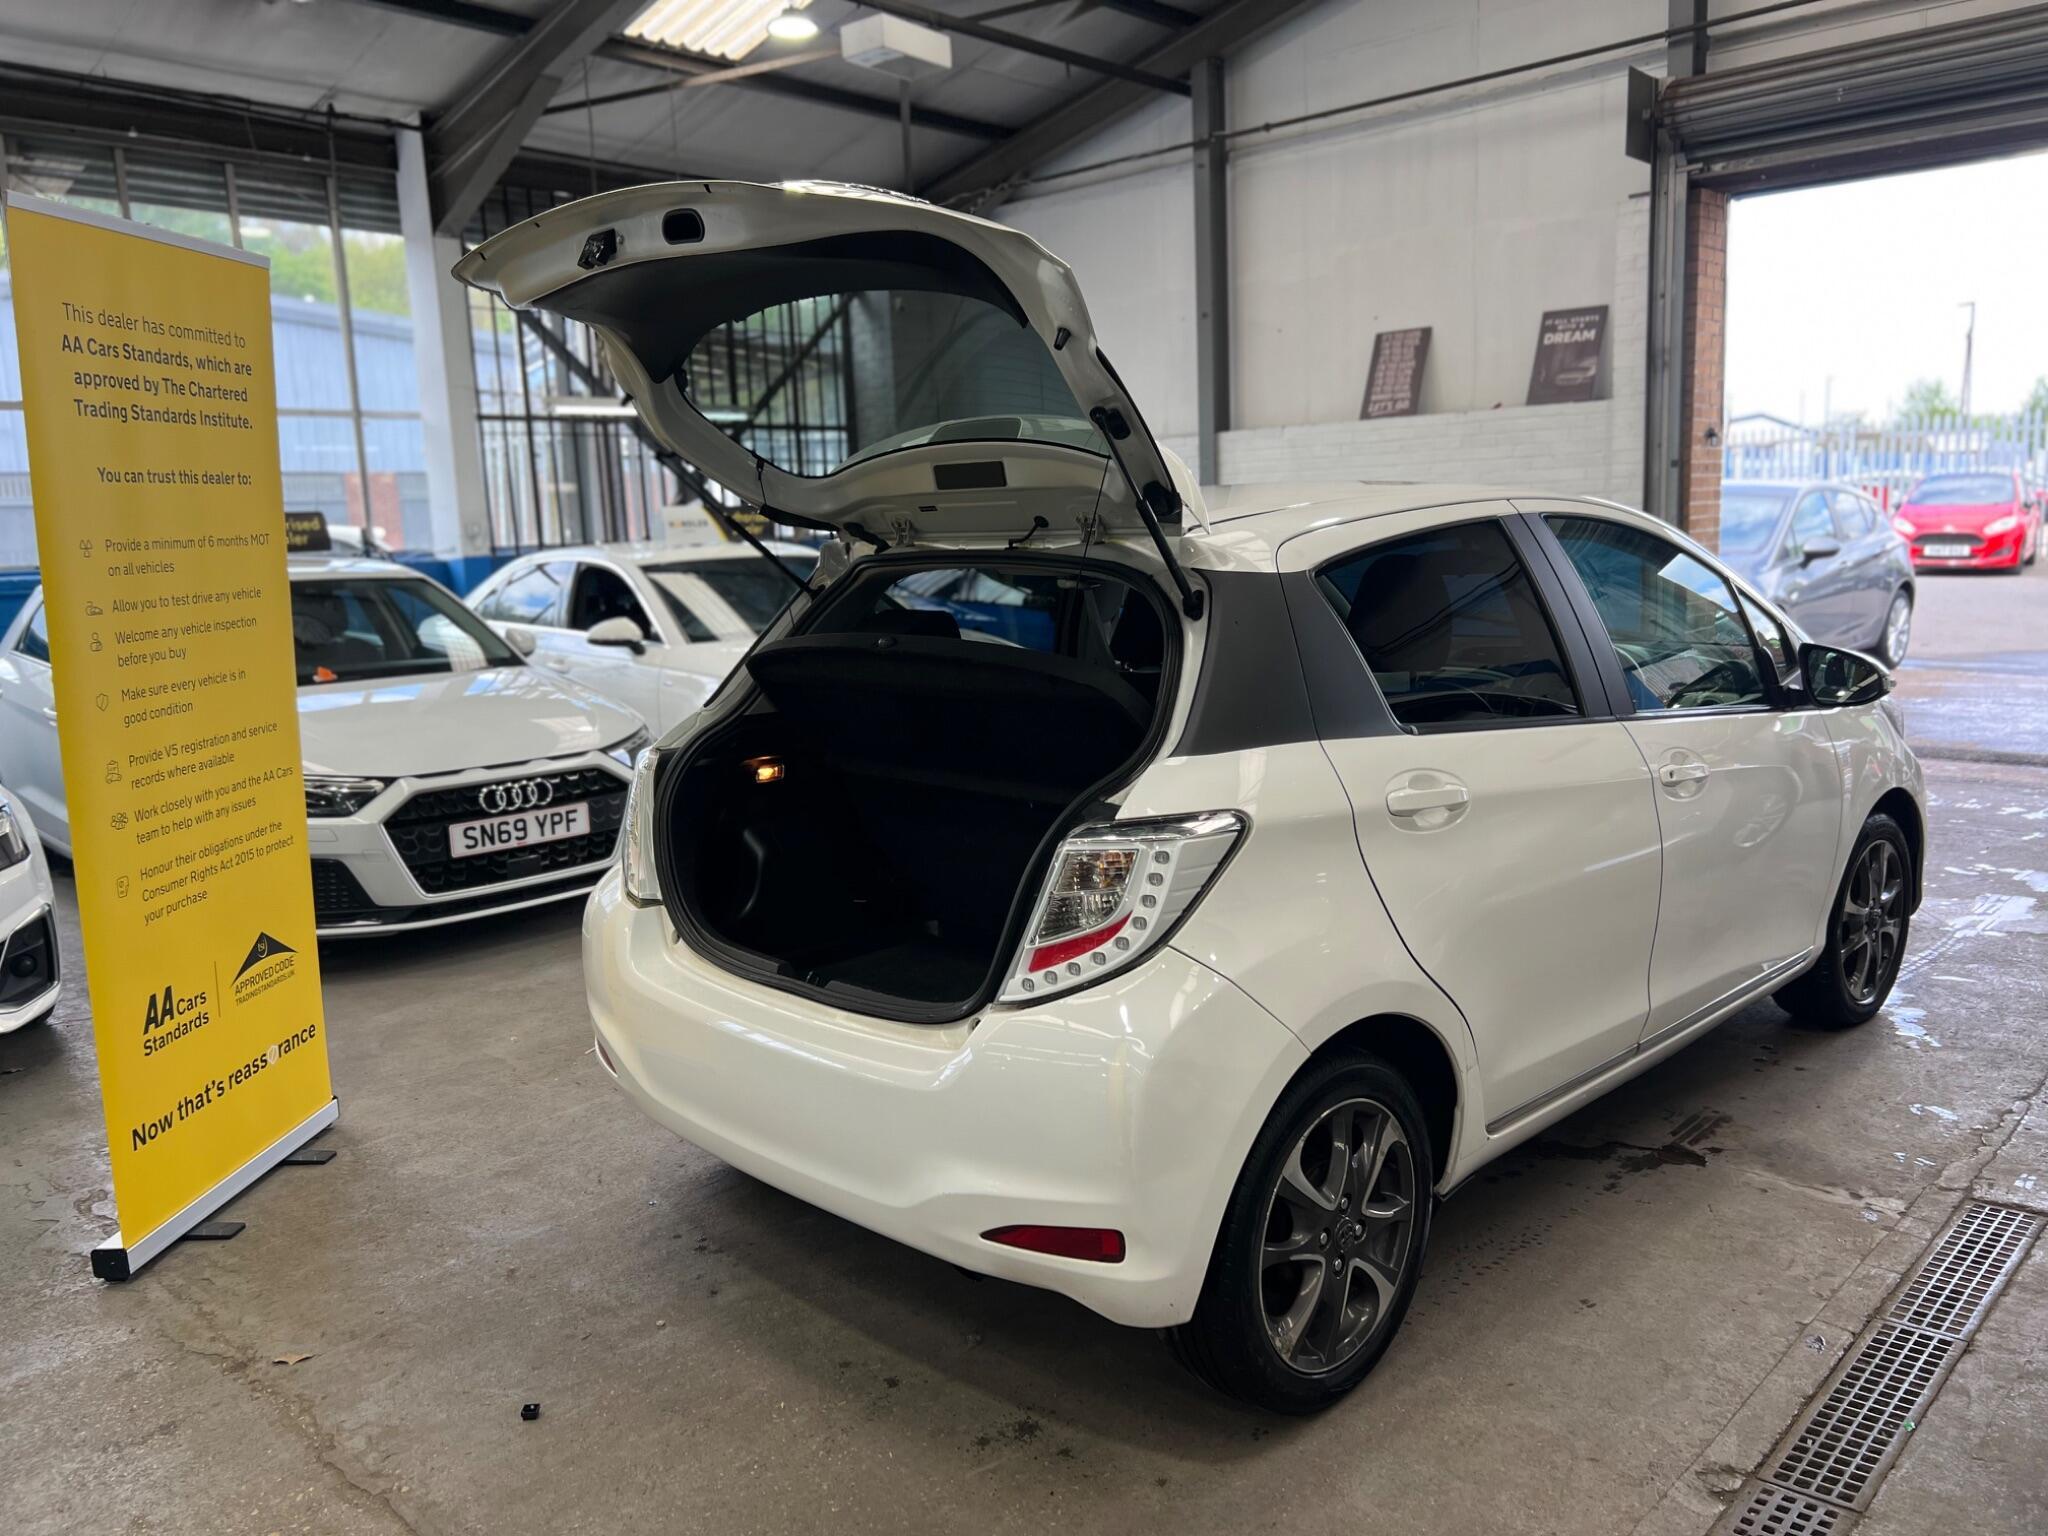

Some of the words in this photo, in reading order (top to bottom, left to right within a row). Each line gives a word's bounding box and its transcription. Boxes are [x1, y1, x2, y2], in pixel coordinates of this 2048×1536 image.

[62, 302, 94, 324] This
[98, 309, 138, 331] dealer
[142, 316, 165, 336] has
[169, 323, 231, 346] committed
[234, 332, 246, 348] to
[1543, 328, 1597, 346] DREAM
[62, 334, 83, 354] AA
[87, 338, 119, 358] Cars
[122, 342, 193, 370] Standards,
[195, 356, 231, 374] which
[234, 362, 252, 376] are
[74, 370, 140, 391] approved
[144, 376, 159, 396] by
[162, 378, 186, 396] The
[188, 381, 248, 402] Chartered
[74, 399, 128, 423] Trading
[131, 404, 196, 425] Standards
[200, 410, 253, 430] Institute.
[97, 467, 120, 483] You
[124, 470, 144, 484] can
[147, 468, 176, 484] trust
[179, 470, 198, 484] this
[202, 471, 234, 486] dealer
[237, 474, 251, 486] to:
[105, 538, 141, 552] Provide
[144, 540, 150, 550] a
[152, 536, 195, 550] minimum
[198, 535, 206, 548] of
[208, 535, 214, 548] 6
[216, 534, 248, 546] months
[251, 533, 270, 546] MOT
[108, 564, 120, 576] on
[124, 562, 134, 576] all
[136, 560, 174, 574] vehicles
[112, 599, 138, 613] Allow
[140, 599, 156, 612] you
[160, 596, 170, 607] to
[172, 594, 190, 606] test
[192, 591, 212, 605] drive
[215, 592, 230, 604] any
[232, 586, 261, 600] vehicle
[115, 628, 158, 644] Welcome
[162, 626, 178, 640] any
[181, 621, 211, 636] vehicle
[214, 616, 256, 632] inspection
[118, 652, 147, 668] before
[150, 651, 166, 664] you
[169, 647, 186, 661] buy
[122, 686, 146, 702] Make
[149, 683, 168, 696] sure
[171, 678, 196, 694] every
[198, 671, 227, 687] vehicle
[229, 669, 237, 682] is
[239, 668, 246, 680] in
[124, 710, 148, 728] good
[150, 701, 193, 720] condition
[128, 750, 163, 768] Provide
[164, 744, 178, 758] V5
[180, 734, 230, 755] registration
[232, 728, 247, 741] and
[249, 722, 278, 737] service
[131, 772, 165, 790] records
[167, 762, 196, 780] where
[198, 752, 235, 771] available
[134, 806, 159, 822] Work
[161, 795, 192, 814] closely
[194, 788, 214, 804] with
[215, 786, 230, 801] you
[232, 779, 247, 794] and
[248, 776, 262, 788] the
[263, 770, 274, 783] AA
[276, 766, 293, 778] Cars
[136, 828, 159, 844] team
[161, 825, 170, 836] to
[172, 816, 192, 834] help
[195, 810, 214, 826] with
[216, 806, 230, 820] any
[232, 795, 256, 812] issues
[463, 818, 528, 850] SN69
[535, 809, 578, 837] YPF
[140, 859, 173, 880] Honour
[176, 852, 196, 868] their
[198, 835, 244, 860] obligations
[246, 826, 268, 842] under
[269, 820, 282, 834] the
[142, 876, 188, 902] Consumer
[190, 864, 218, 885] Rights
[220, 856, 234, 870] Act
[235, 848, 254, 866] 2015
[256, 846, 264, 858] to
[266, 835, 294, 856] protect
[144, 906, 164, 926] your
[166, 890, 208, 916] purchase
[234, 966, 274, 996] APPROVED
[274, 956, 295, 974] CODE
[143, 986, 174, 1035] AA
[176, 991, 207, 1016] Cars
[144, 1010, 210, 1056] Standards
[132, 1110, 174, 1151] Now
